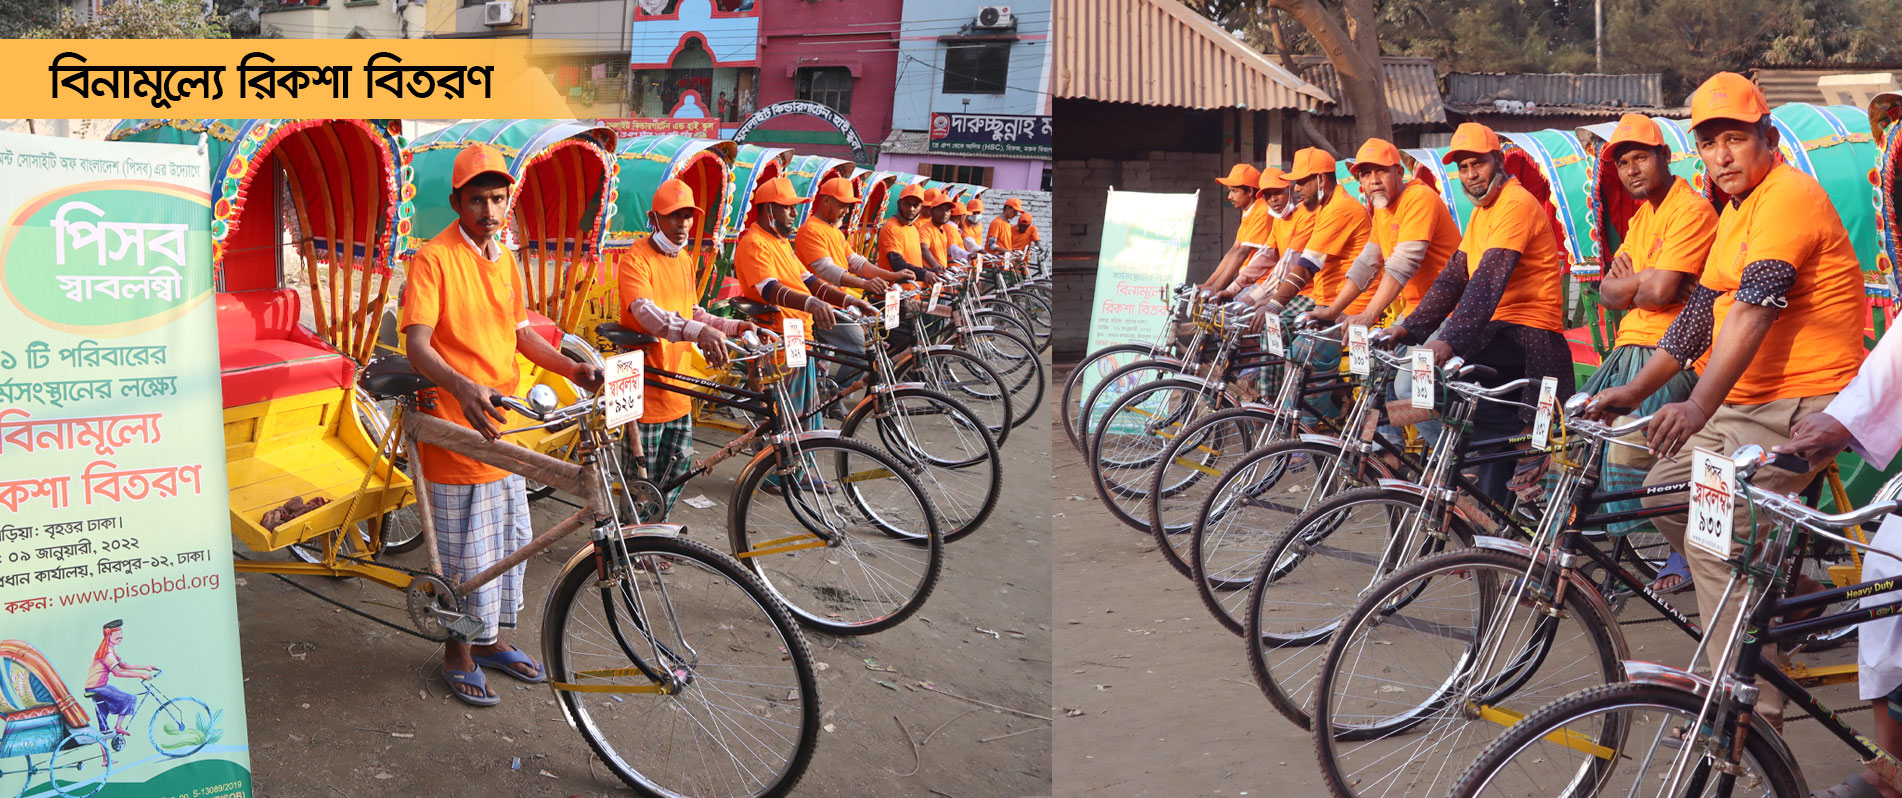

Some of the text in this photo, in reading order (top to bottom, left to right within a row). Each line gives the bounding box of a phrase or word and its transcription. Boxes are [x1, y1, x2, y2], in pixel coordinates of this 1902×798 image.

[17, 151, 57, 170] সোসাইটি
[60, 157, 77, 169] অফ
[80, 158, 119, 174] বাংলাদেশ
[122, 157, 152, 179] (পিসব)
[154, 163, 166, 175] এর
[169, 160, 200, 179] উদ্যোগে
[50, 201, 189, 267] পিসব
[56, 266, 183, 302] স্বাবলম্বী
[25, 340, 50, 370] টি
[59, 339, 167, 368] পরিবারের
[119, 375, 178, 398] লক্ষ্যে
[608, 368, 641, 397] স্বাবলম্বী
[675, 374, 721, 388] Heavy Duty
[615, 396, 634, 413] ৯২৬
[81, 460, 202, 505] বিতরণ
[1647, 481, 1686, 495] Heavy
[1695, 481, 1731, 517] স্বাবলম্বী
[43, 520, 83, 539] বৃহত্তর
[1699, 511, 1722, 537] ৯৩৩
[9, 537, 140, 562] ০৯ জানুয়ারী, ২০২২
[34, 565, 93, 583] কার্যালয়,
[59, 573, 220, 607] www.pisobbd.org
[1846, 580, 1894, 599] Heavy Duty
[1643, 586, 1687, 623] NEELAM
